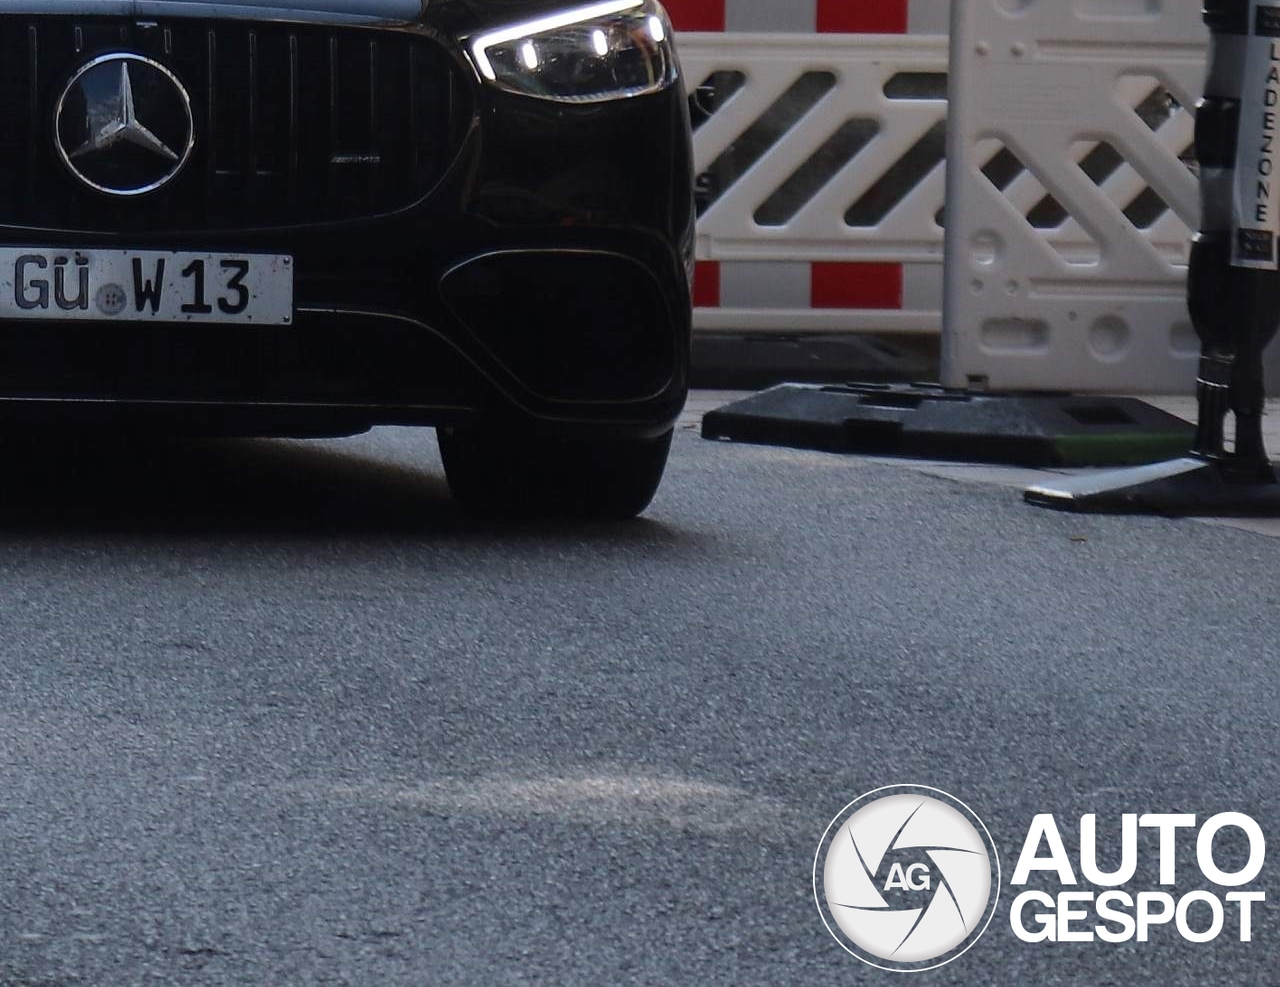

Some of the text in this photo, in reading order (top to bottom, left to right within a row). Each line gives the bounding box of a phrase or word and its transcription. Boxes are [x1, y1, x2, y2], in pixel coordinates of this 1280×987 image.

[1255, 42, 1280, 222] LADEZONE
[14, 253, 90, 311] GÜ
[131, 257, 166, 313] W
[180, 258, 251, 315] 13
